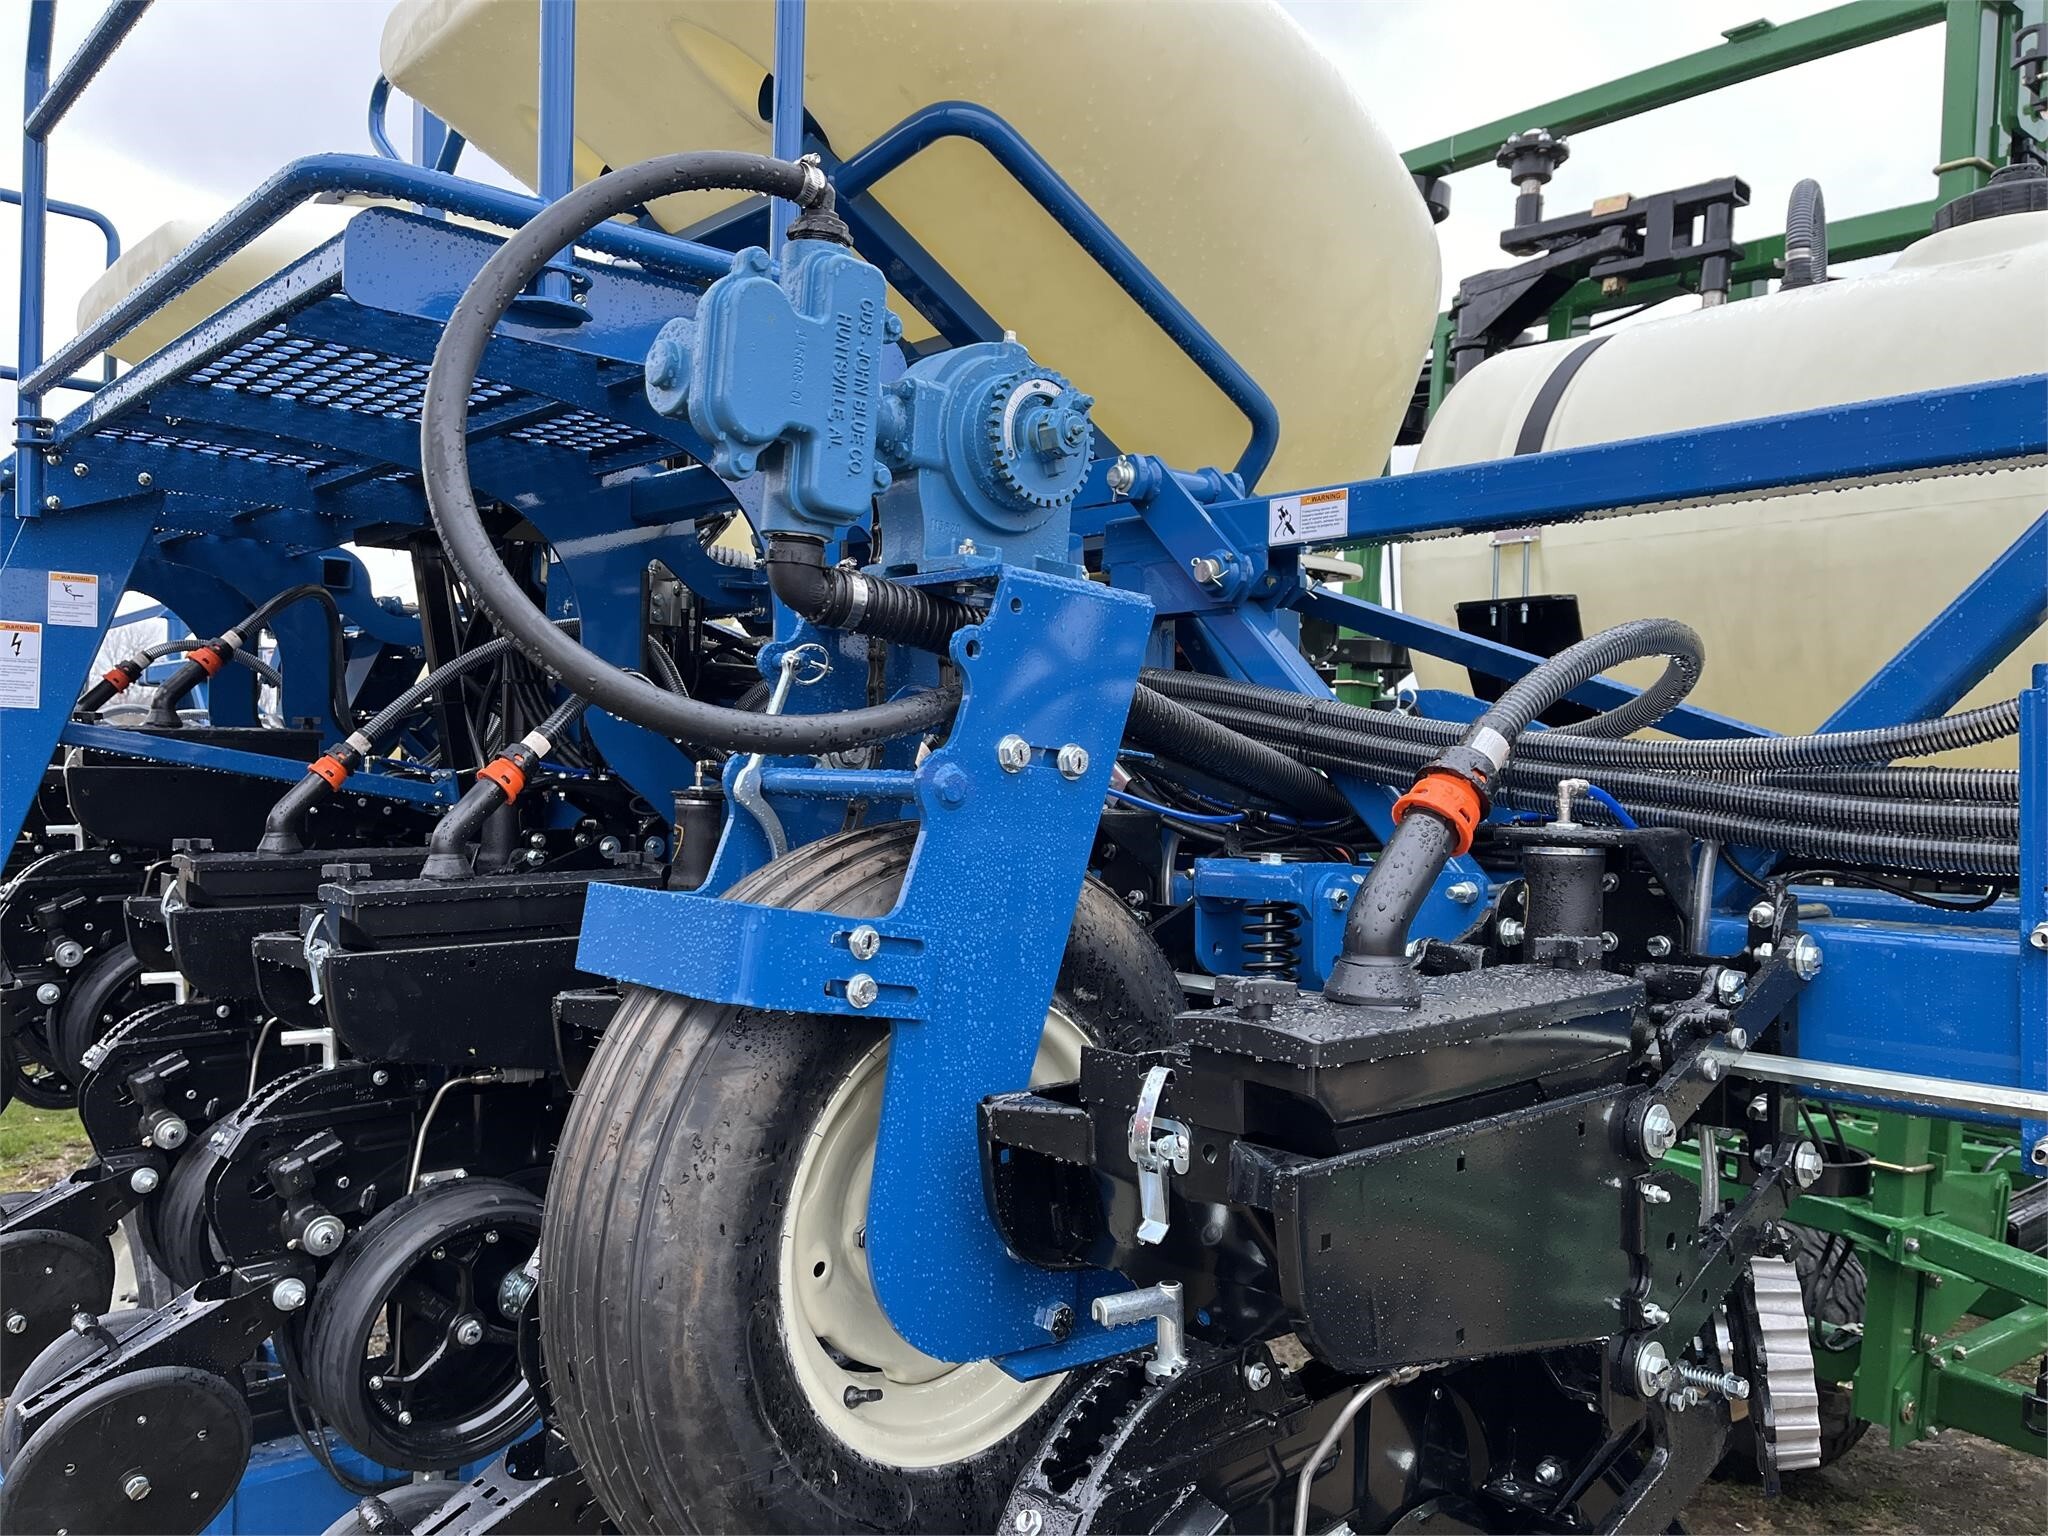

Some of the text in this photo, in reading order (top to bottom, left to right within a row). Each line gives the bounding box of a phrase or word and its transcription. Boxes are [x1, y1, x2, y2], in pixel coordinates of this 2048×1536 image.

[859, 299, 874, 336] CDS
[827, 312, 852, 422] HUNTSVILLE,
[853, 346, 871, 396] JOHN
[850, 398, 867, 446] BLUE
[848, 449, 864, 478] CO.
[1311, 491, 1341, 502] WARNING
